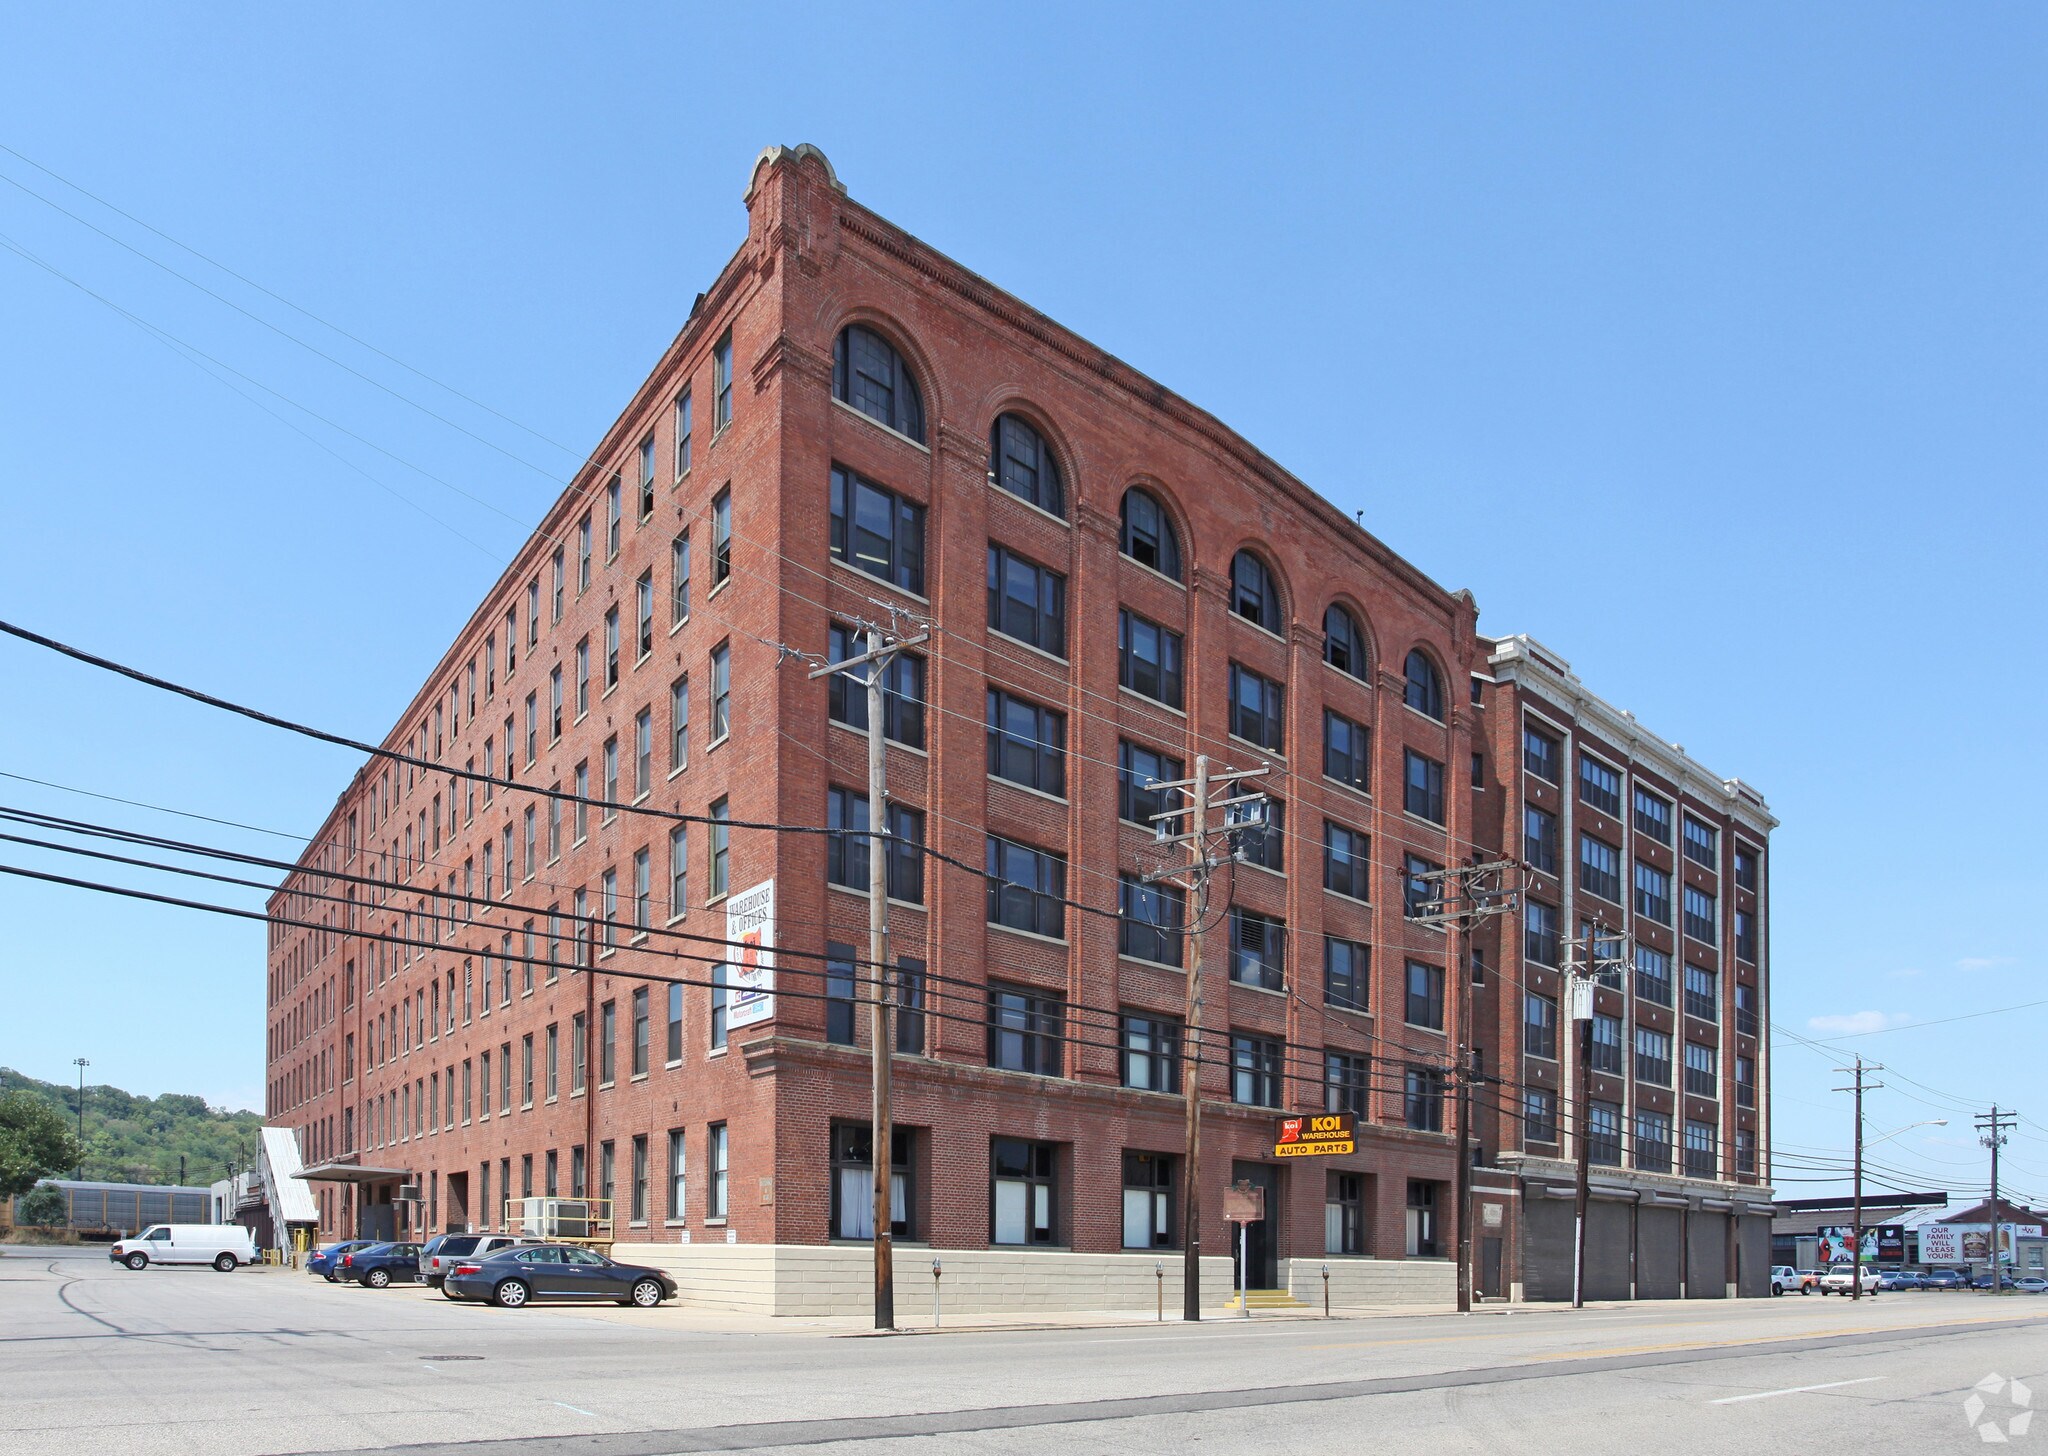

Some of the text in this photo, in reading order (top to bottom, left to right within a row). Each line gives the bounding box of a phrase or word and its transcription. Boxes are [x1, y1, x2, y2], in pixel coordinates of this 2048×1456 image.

[730, 888, 770, 919] WAREHOUSE
[731, 907, 767, 935] & OFFICES
[1311, 1116, 1340, 1131] KOI
[1301, 1131, 1350, 1140] WAREHOUSE
[1280, 1144, 1348, 1155] AUTO PARTS
